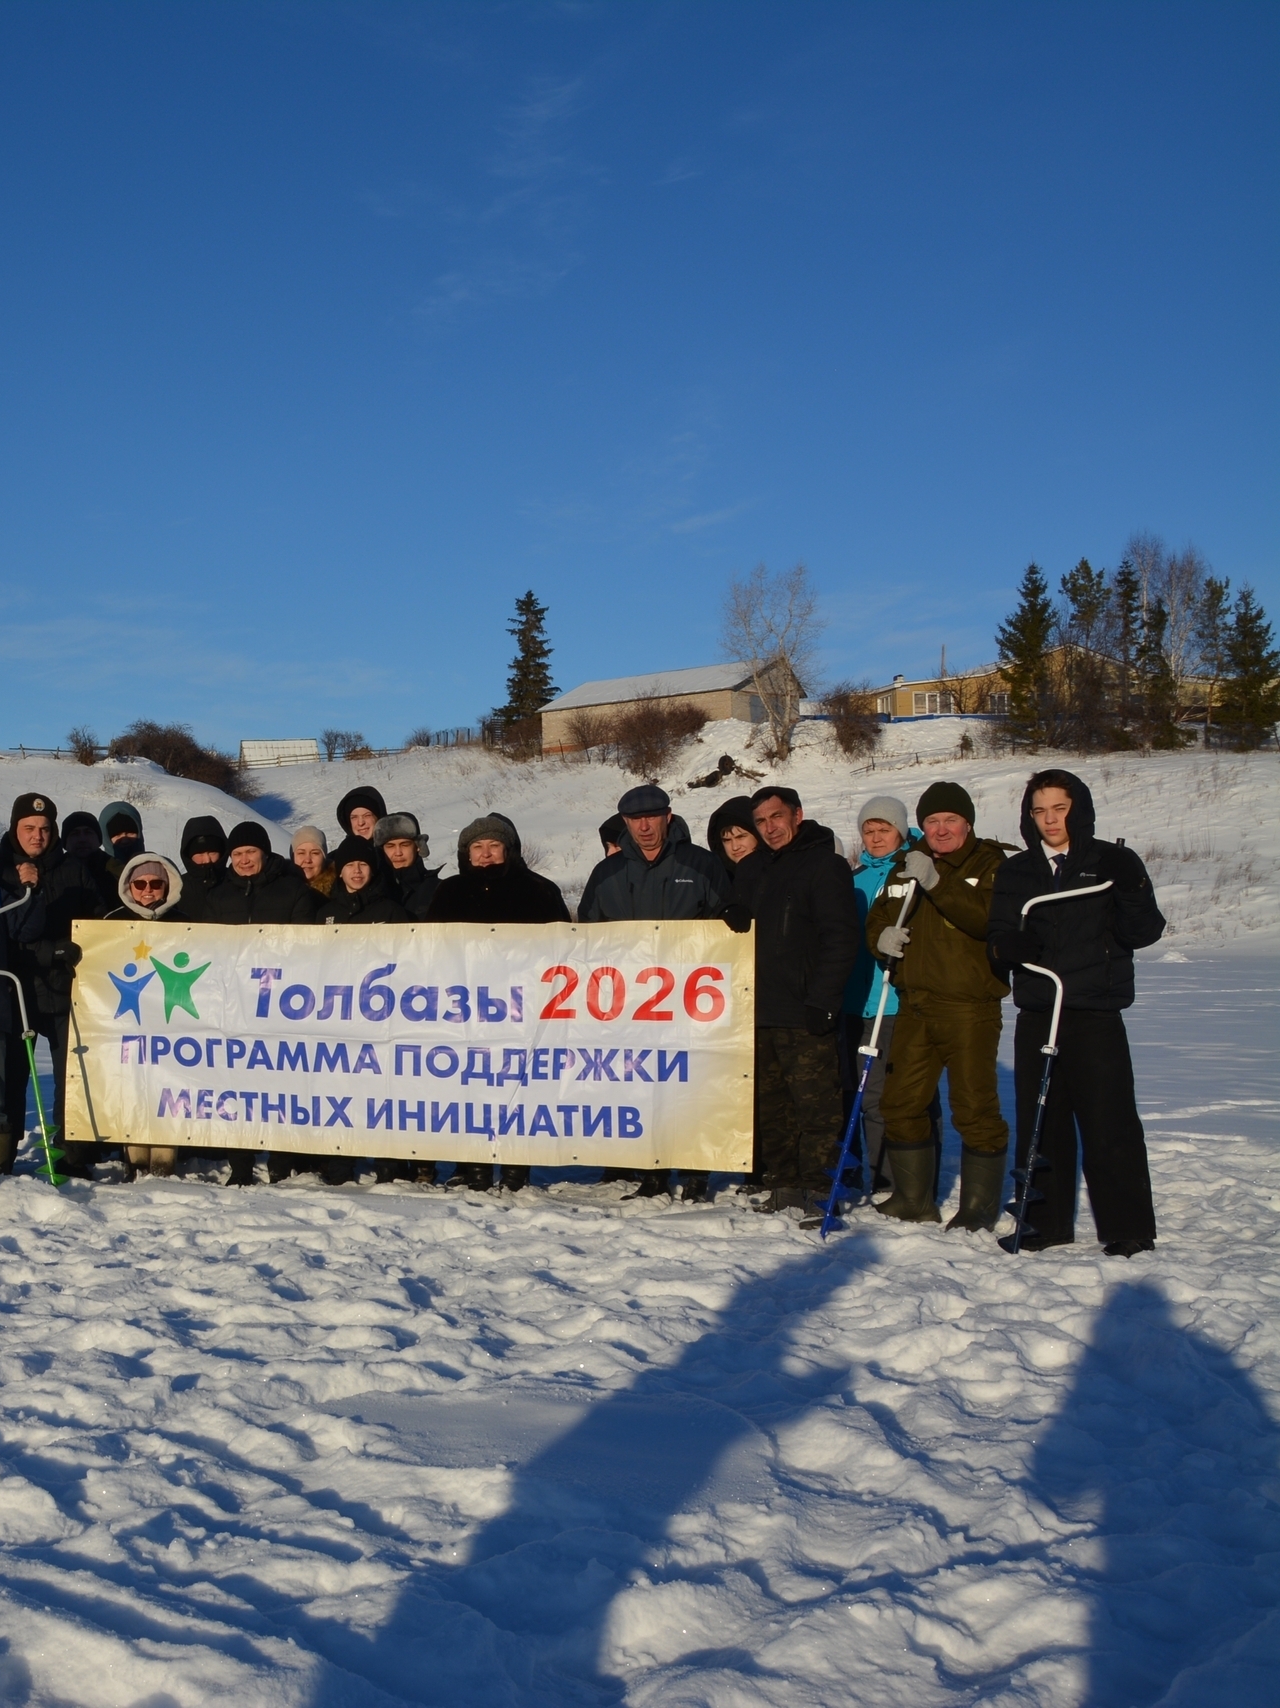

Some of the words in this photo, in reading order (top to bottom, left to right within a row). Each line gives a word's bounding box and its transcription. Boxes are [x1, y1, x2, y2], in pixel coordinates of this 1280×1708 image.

[251, 963, 523, 1023] Толбазы
[539, 966, 725, 1022] 2026
[121, 1035, 382, 1074] ПРОГРАММА
[394, 1044, 688, 1086] ПОДДЕРЖКИ
[157, 1088, 354, 1128] МЕСТНЫХ
[366, 1098, 644, 1141] ИНИЦИАТИВ
